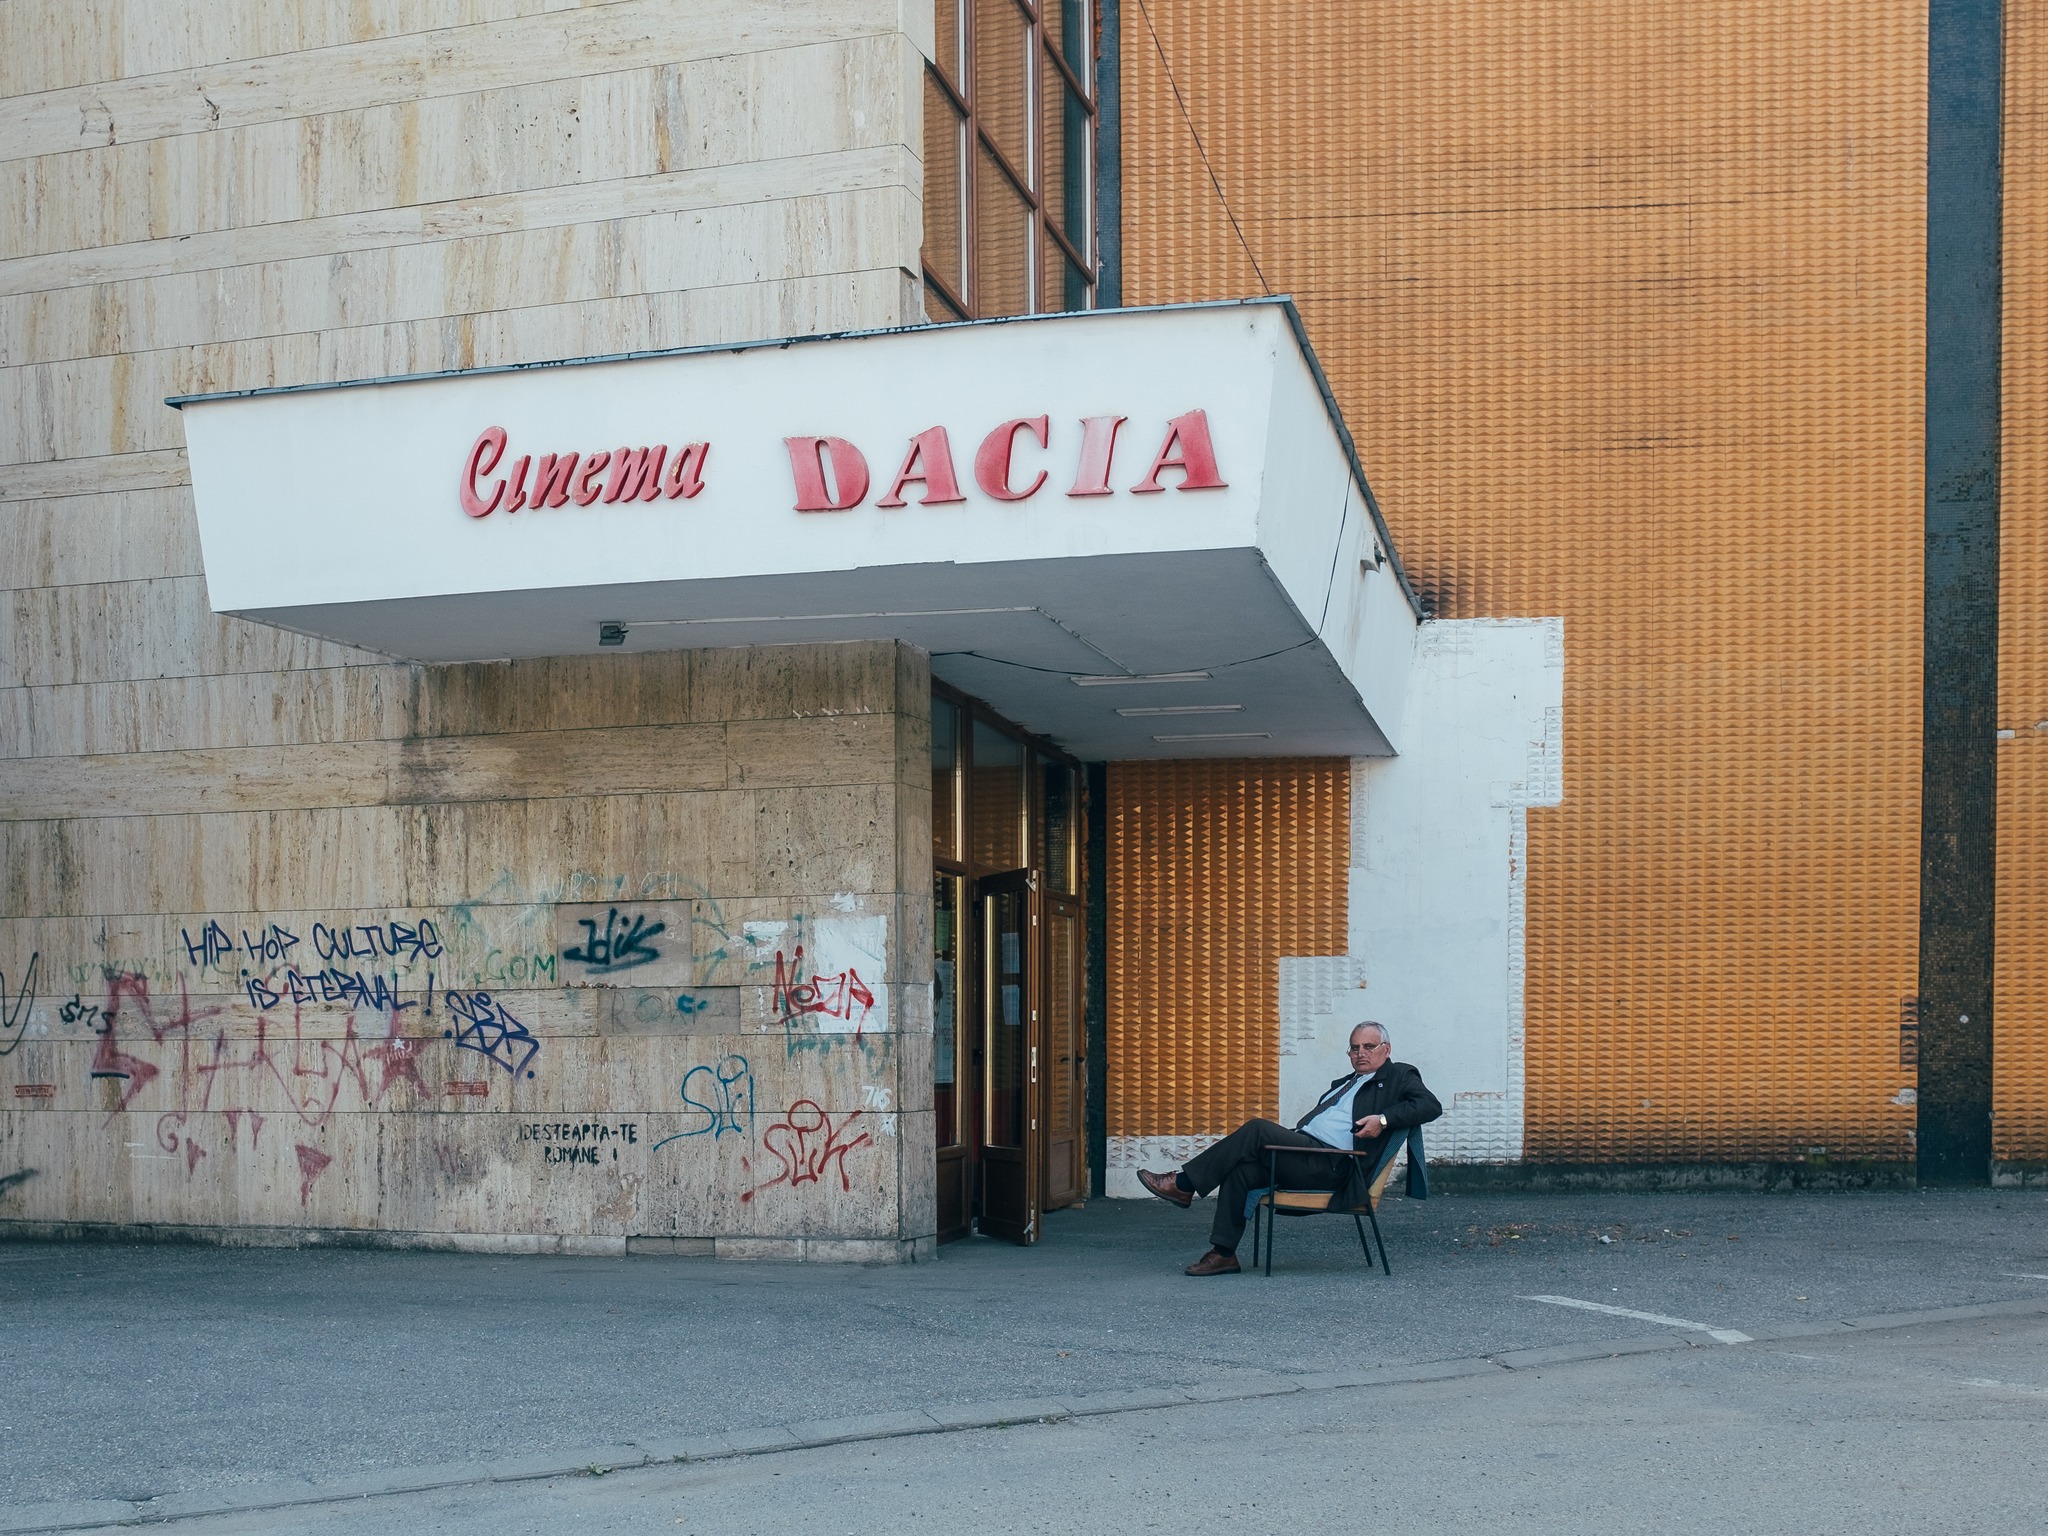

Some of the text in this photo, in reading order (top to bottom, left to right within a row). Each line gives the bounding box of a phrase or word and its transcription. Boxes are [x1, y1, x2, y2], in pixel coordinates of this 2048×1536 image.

[459, 408, 1230, 518] Cinema DACIA
[287, 967, 417, 1012] ETERNAL
